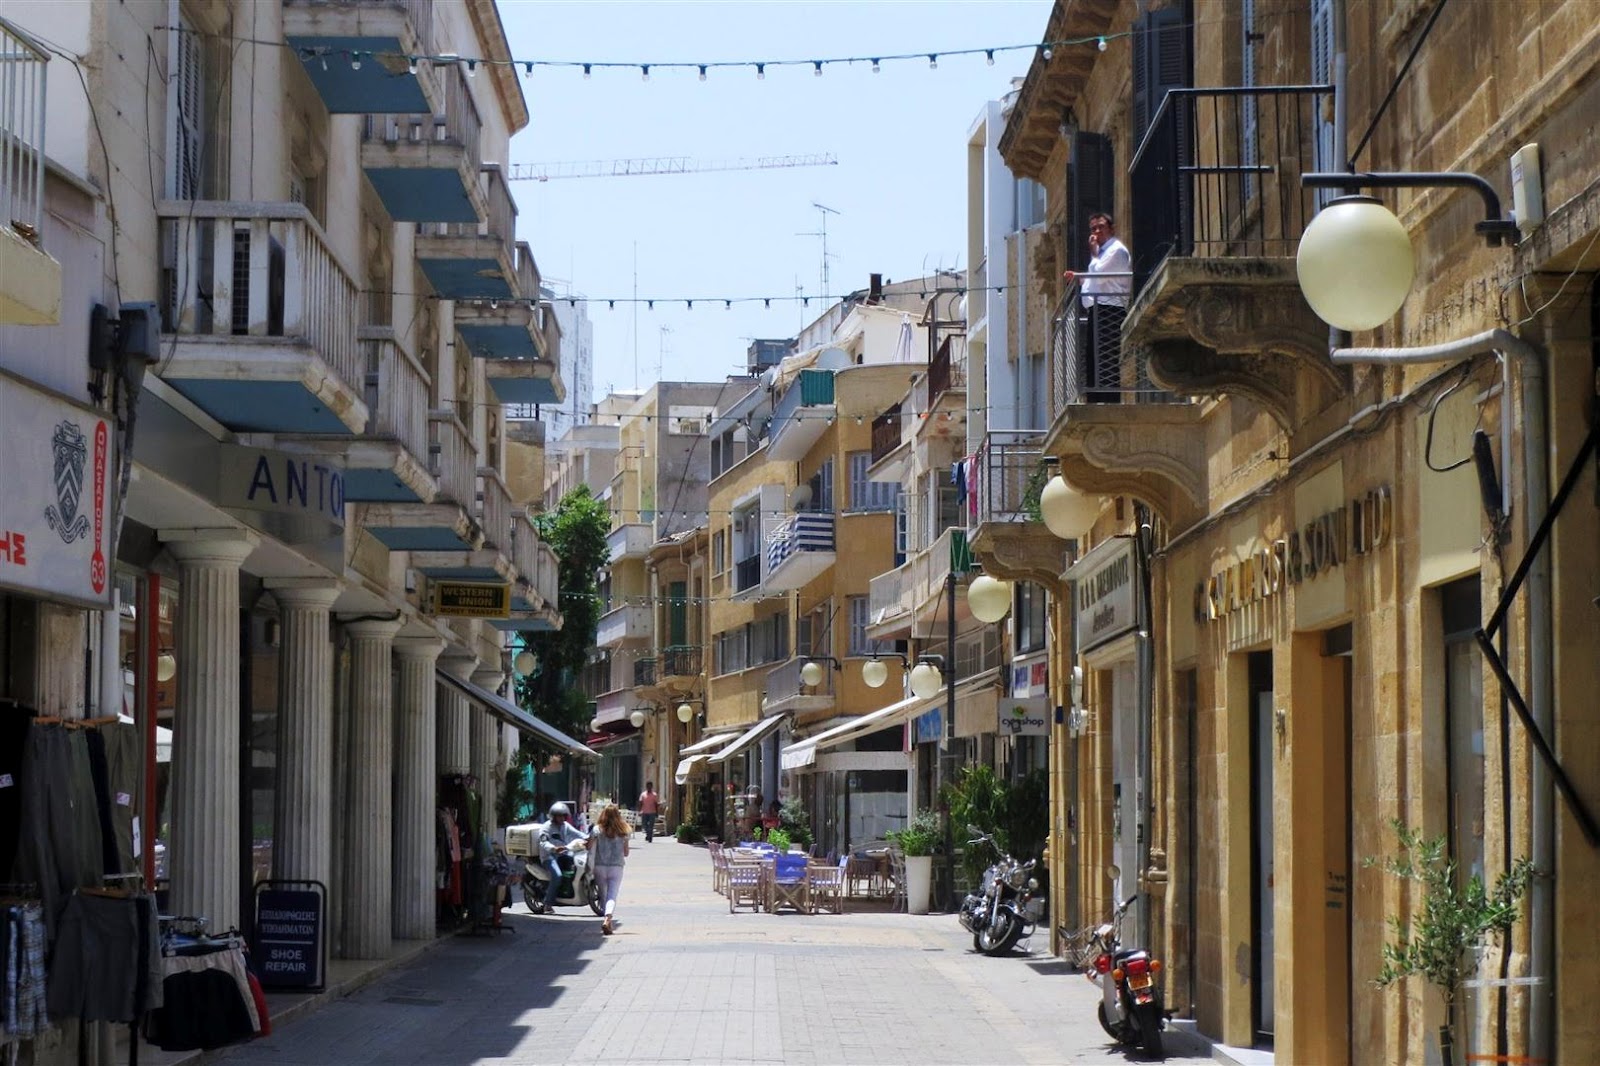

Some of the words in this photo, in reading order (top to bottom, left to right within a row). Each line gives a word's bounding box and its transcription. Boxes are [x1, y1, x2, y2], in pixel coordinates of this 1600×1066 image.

[247, 455, 345, 520] ANTO
[91, 560, 105, 585] 63
[442, 587, 493, 597] WESTERN
[458, 597, 493, 606] UNION
[271, 949, 302, 960] SHOE
[265, 961, 306, 972] REPAIR
